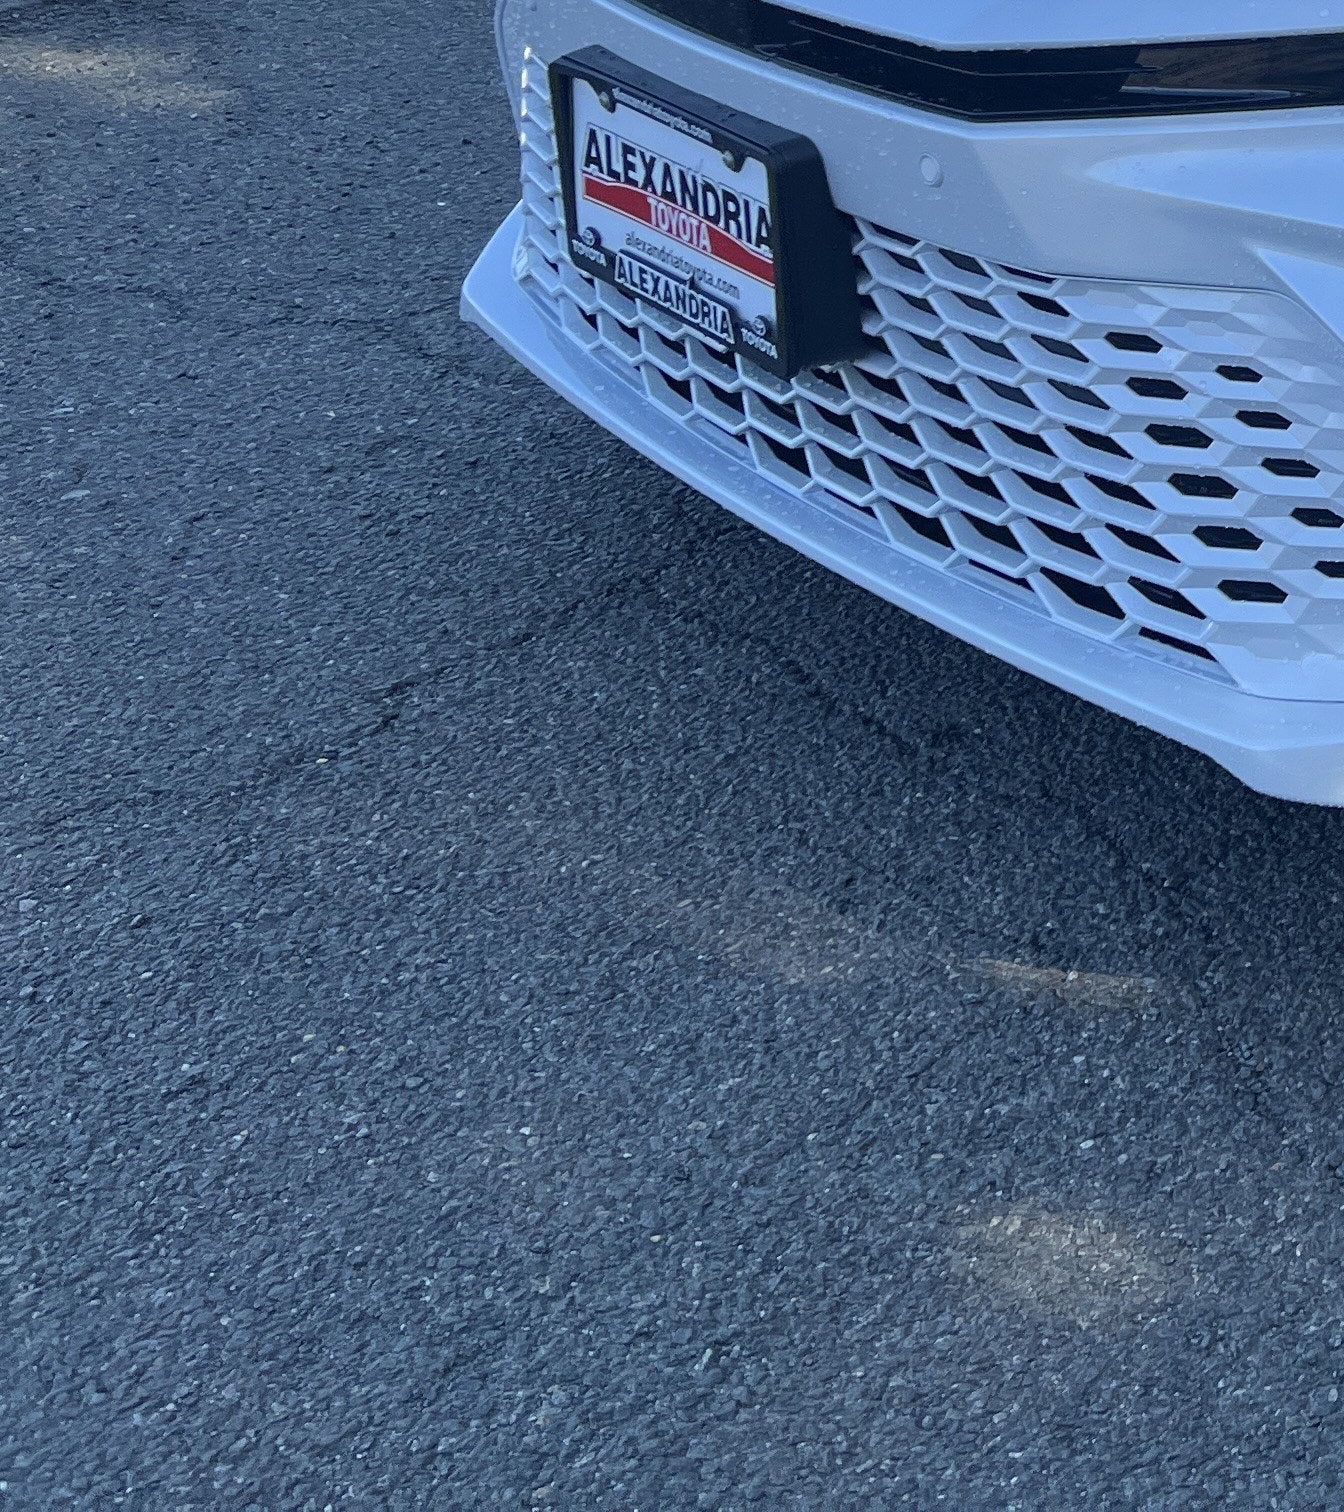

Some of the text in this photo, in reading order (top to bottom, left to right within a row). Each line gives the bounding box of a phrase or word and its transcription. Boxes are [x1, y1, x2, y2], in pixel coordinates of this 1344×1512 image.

[583, 127, 772, 251] ALEXANDRIA
[647, 197, 713, 253] TOYOTA
[571, 239, 607, 268] TOYOTA
[616, 255, 734, 342] ALEXANDRIA
[741, 327, 779, 360] TOYOTA
